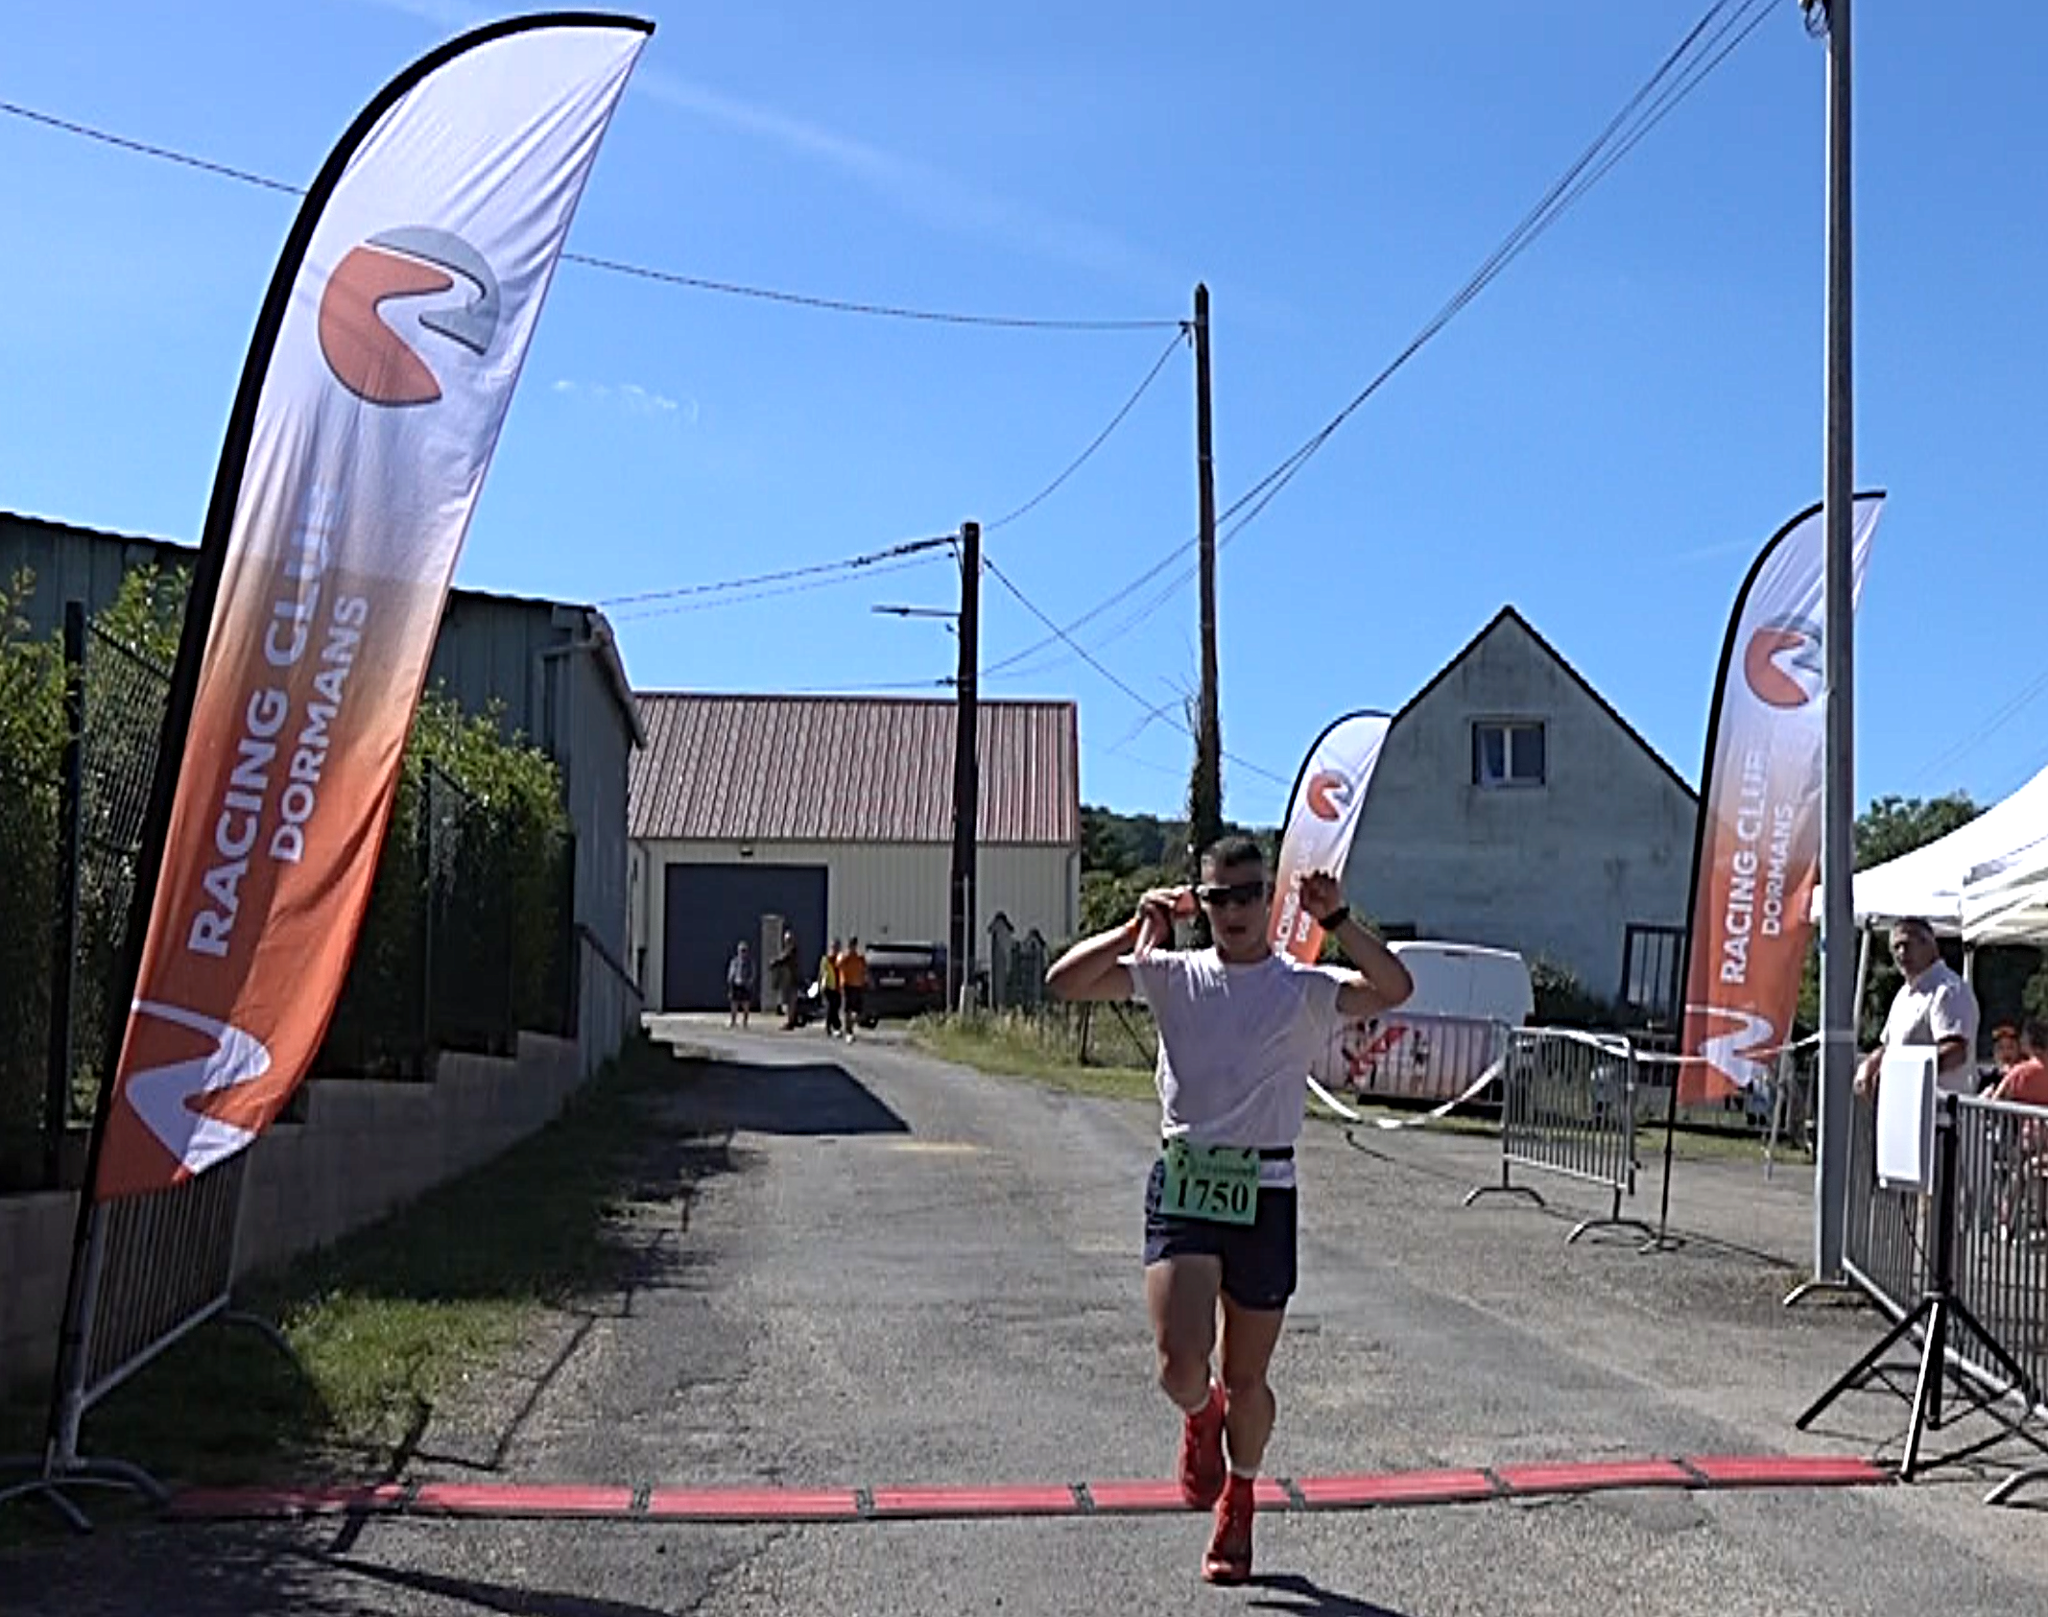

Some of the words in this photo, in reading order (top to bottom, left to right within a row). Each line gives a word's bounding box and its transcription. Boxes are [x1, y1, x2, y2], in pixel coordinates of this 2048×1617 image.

[269, 596, 368, 863] DORMANS
[187, 689, 288, 957] RACING
[1761, 802, 1793, 936] DORMANS
[1720, 850, 1758, 984] RACING
[1178, 1177, 1249, 1214] 1750
